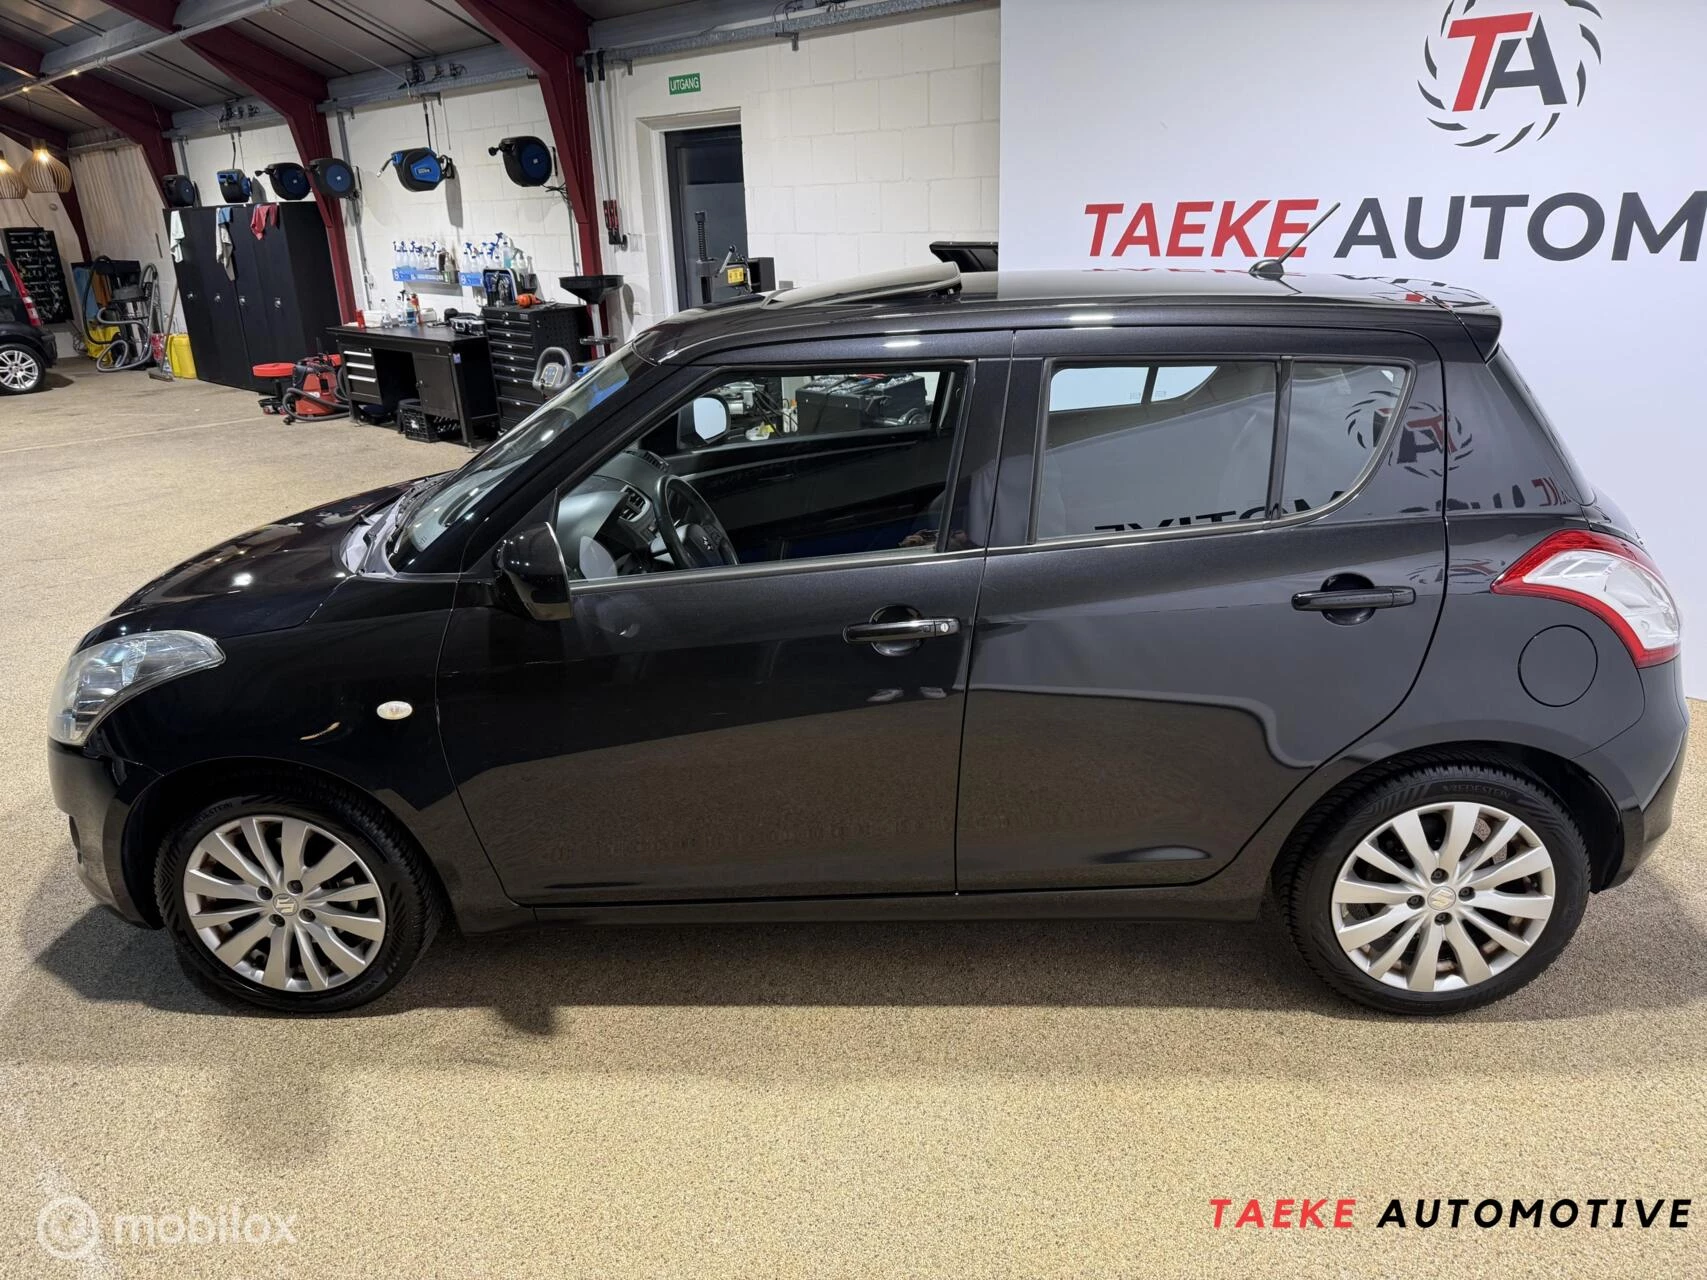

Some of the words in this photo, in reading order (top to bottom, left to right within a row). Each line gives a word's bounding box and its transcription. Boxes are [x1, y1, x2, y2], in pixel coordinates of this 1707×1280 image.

[670, 76, 700, 91] UITGANG
[1448, 12, 1568, 112] TA
[1084, 199, 1319, 258] TAEKE
[1333, 190, 1707, 262] AUTOM
